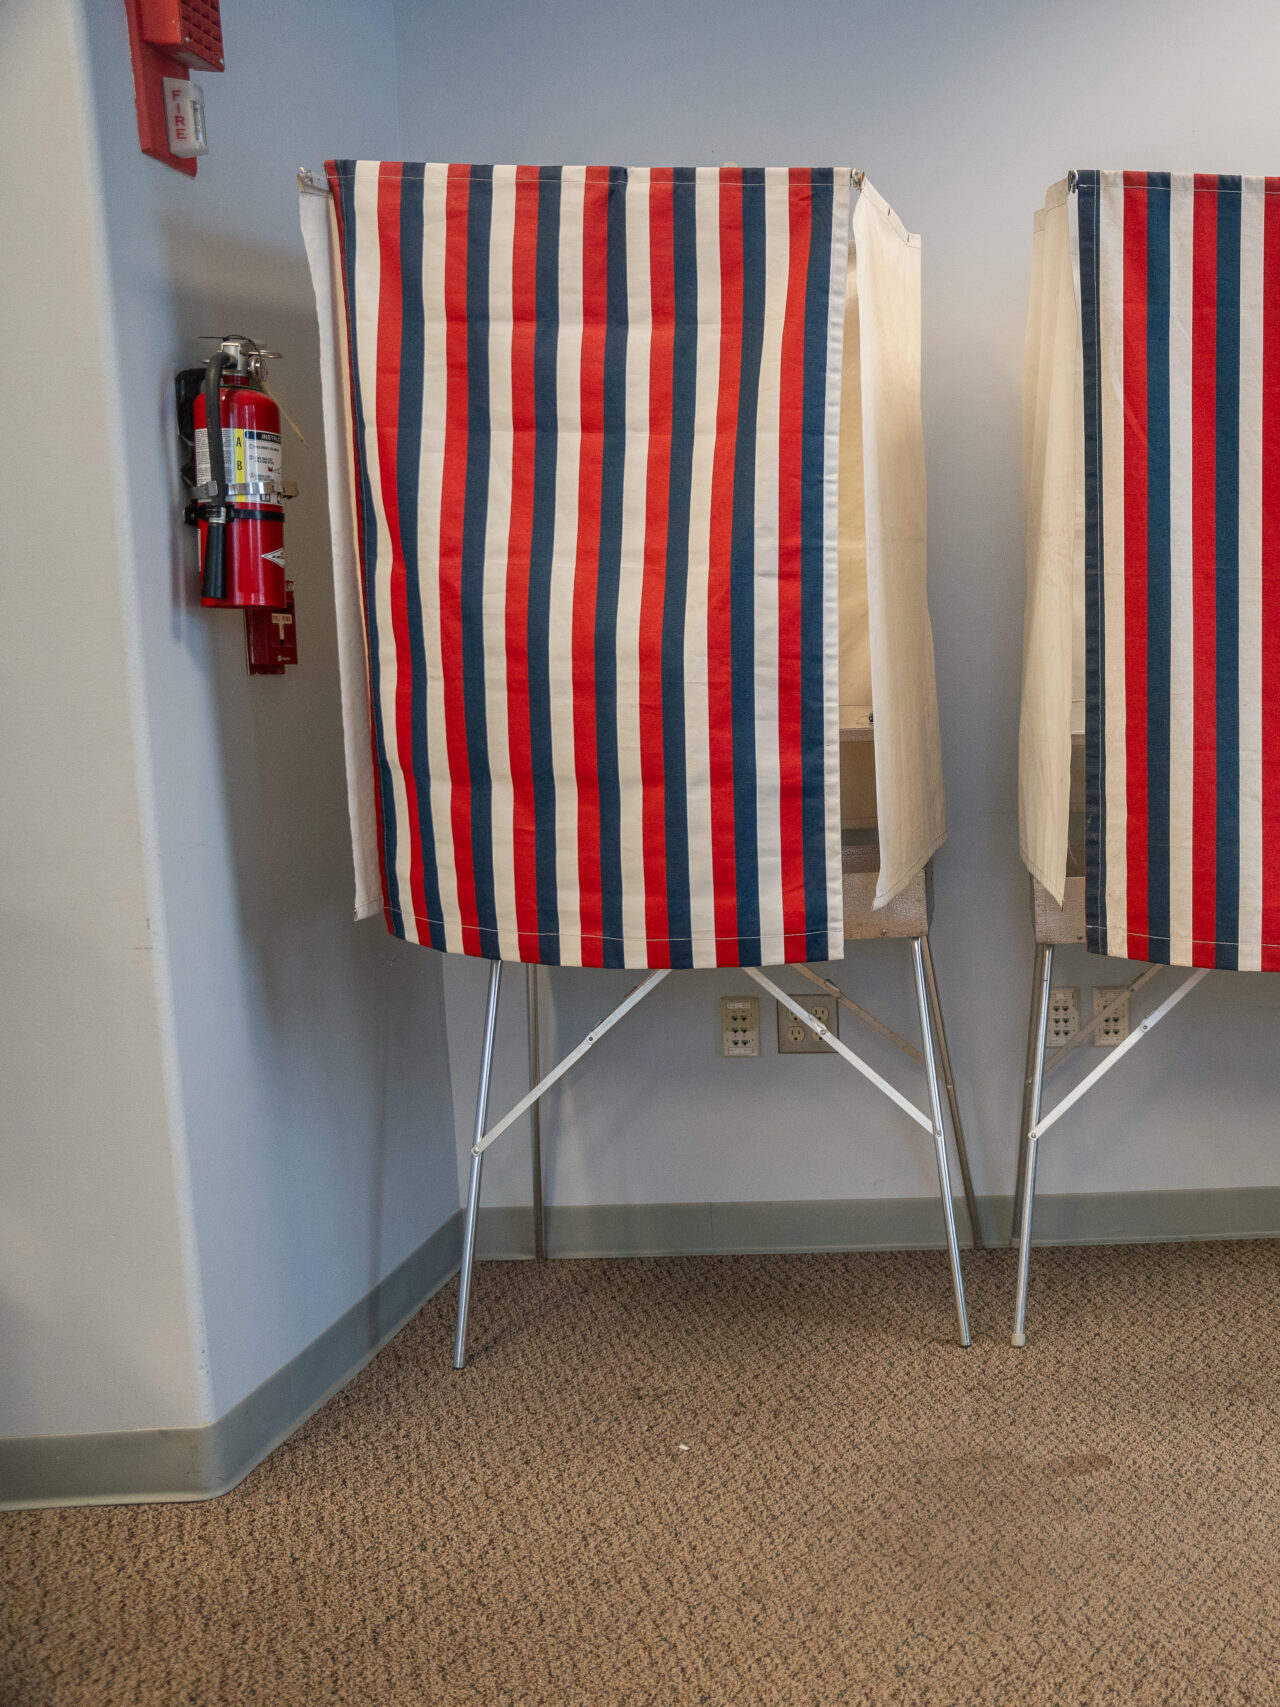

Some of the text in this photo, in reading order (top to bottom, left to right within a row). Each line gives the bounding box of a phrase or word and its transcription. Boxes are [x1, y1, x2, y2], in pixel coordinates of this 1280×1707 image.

[171, 90, 187, 140] FIRE
[236, 437, 242, 447] A
[236, 461, 243, 470] B
